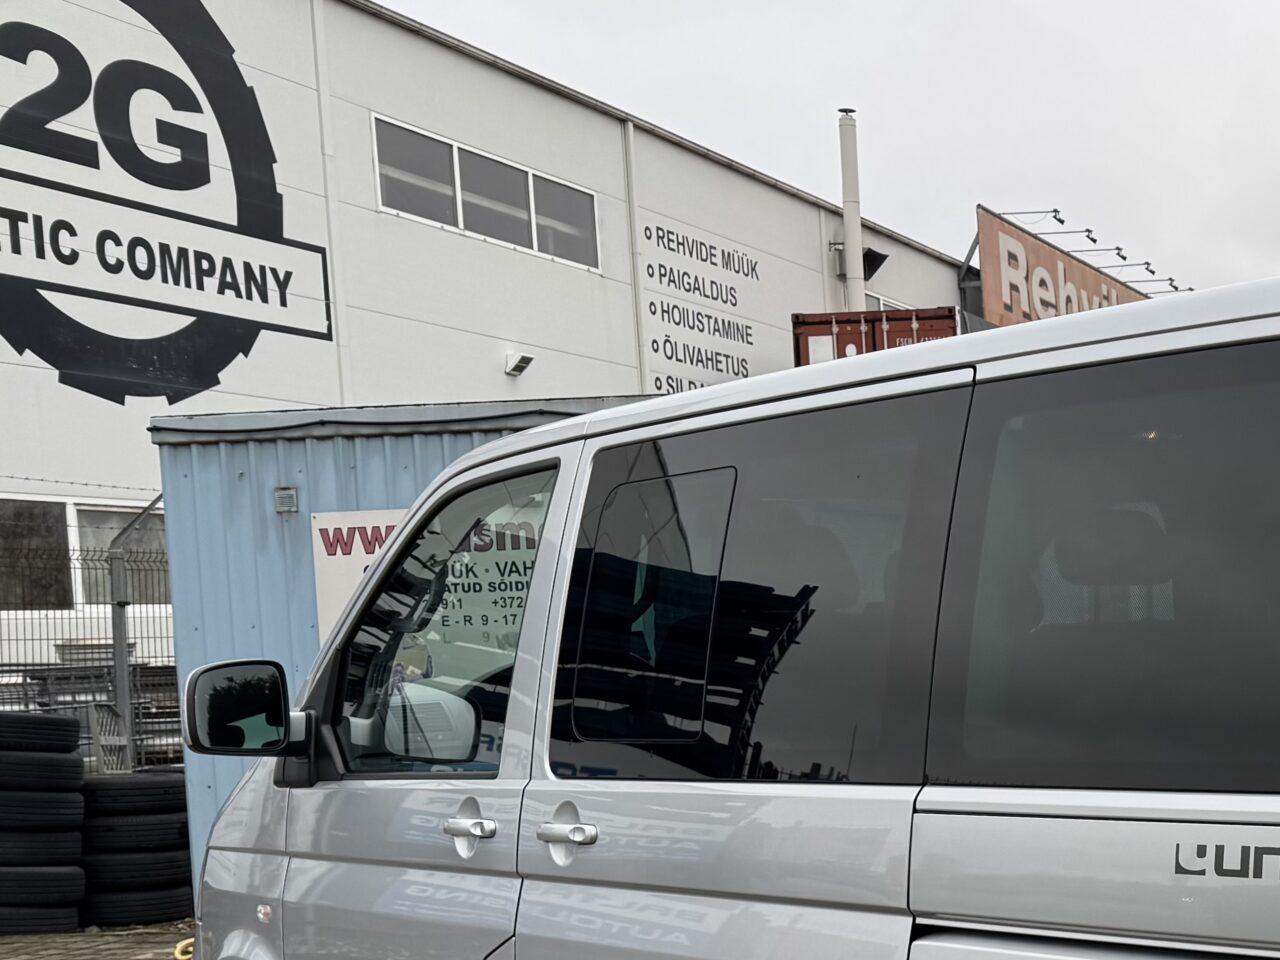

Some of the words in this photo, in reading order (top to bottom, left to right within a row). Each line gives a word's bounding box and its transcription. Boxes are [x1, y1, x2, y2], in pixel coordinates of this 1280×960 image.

[0, 206, 80, 266] TIC
[96, 229, 293, 308] COMPANY
[656, 226, 718, 266] REHVIDE
[721, 249, 759, 281] MÜÜK
[658, 263, 738, 307] PAIGALDUS
[660, 300, 753, 345] HOIUSTAMINE
[663, 334, 749, 379] ÕLIVAHETUS
[443, 581, 483, 594] ATUD
[446, 560, 478, 579] ÜK
[495, 560, 536, 577] VAH
[441, 597, 463, 610] 911
[491, 596, 524, 609] +372
[502, 614, 518, 626] 17
